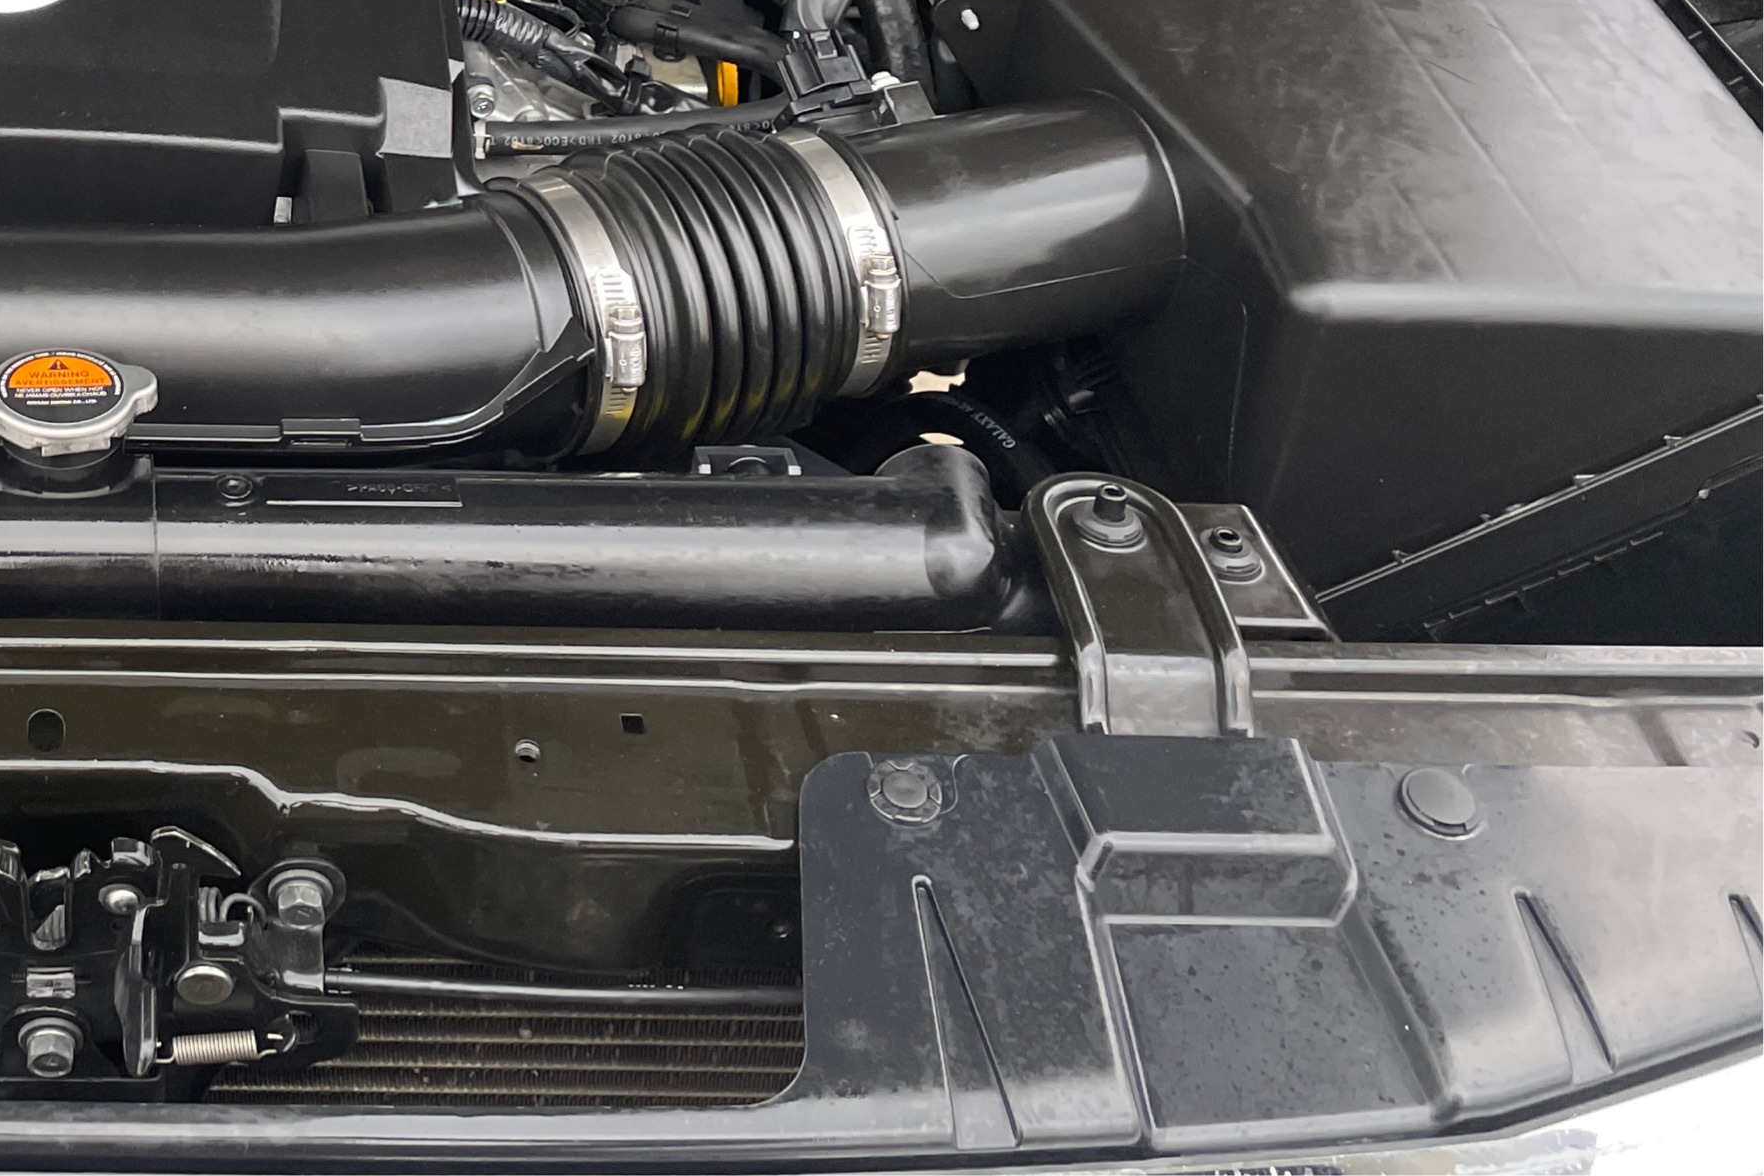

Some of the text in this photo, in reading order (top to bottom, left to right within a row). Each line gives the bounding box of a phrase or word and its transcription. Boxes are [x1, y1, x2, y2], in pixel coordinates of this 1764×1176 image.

[29, 370, 90, 379] WARNING
[15, 378, 105, 386] AVERTISSEMENT
[970, 412, 1016, 449] GALAXY
